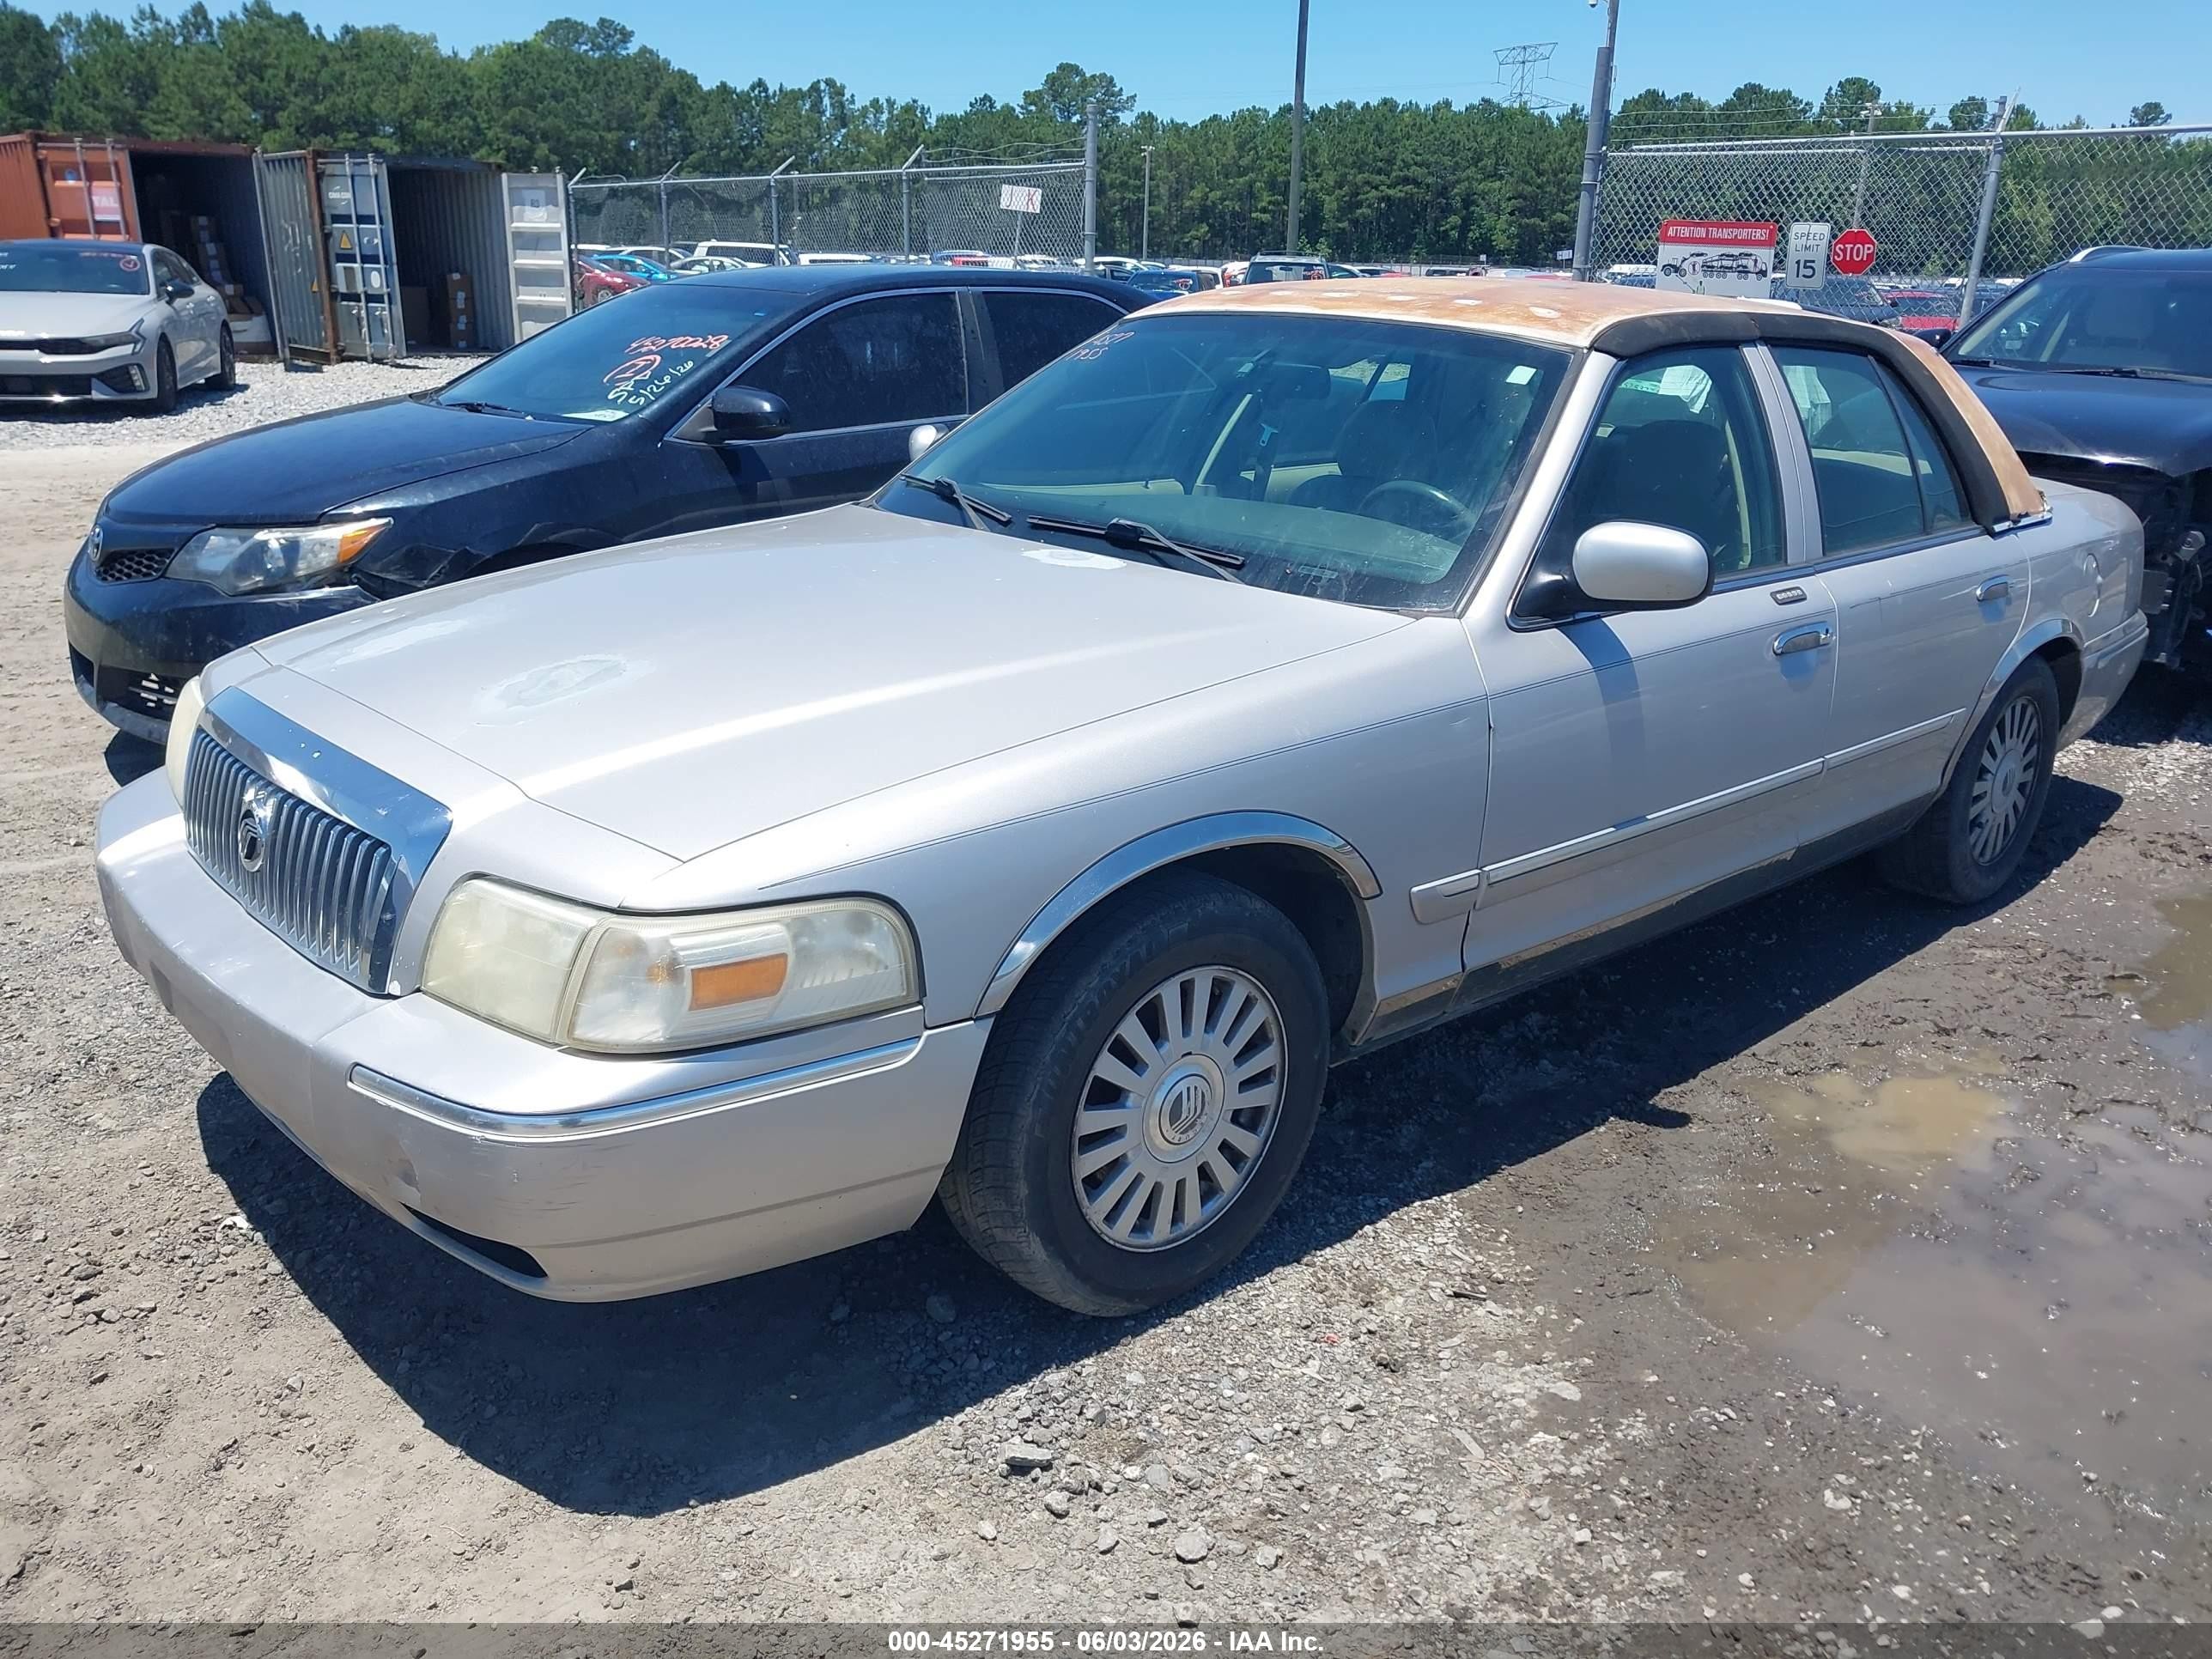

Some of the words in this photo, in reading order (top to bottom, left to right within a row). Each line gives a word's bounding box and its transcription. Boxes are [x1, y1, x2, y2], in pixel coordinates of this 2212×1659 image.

[1667, 226, 1706, 238] ATTENTION
[1708, 227, 1770, 240] TRANSPORTERS!
[1793, 232, 1826, 241] SPEED
[1795, 244, 1820, 252] LIMIT
[1834, 244, 1874, 261] STOP
[1795, 258, 1816, 279] 15
